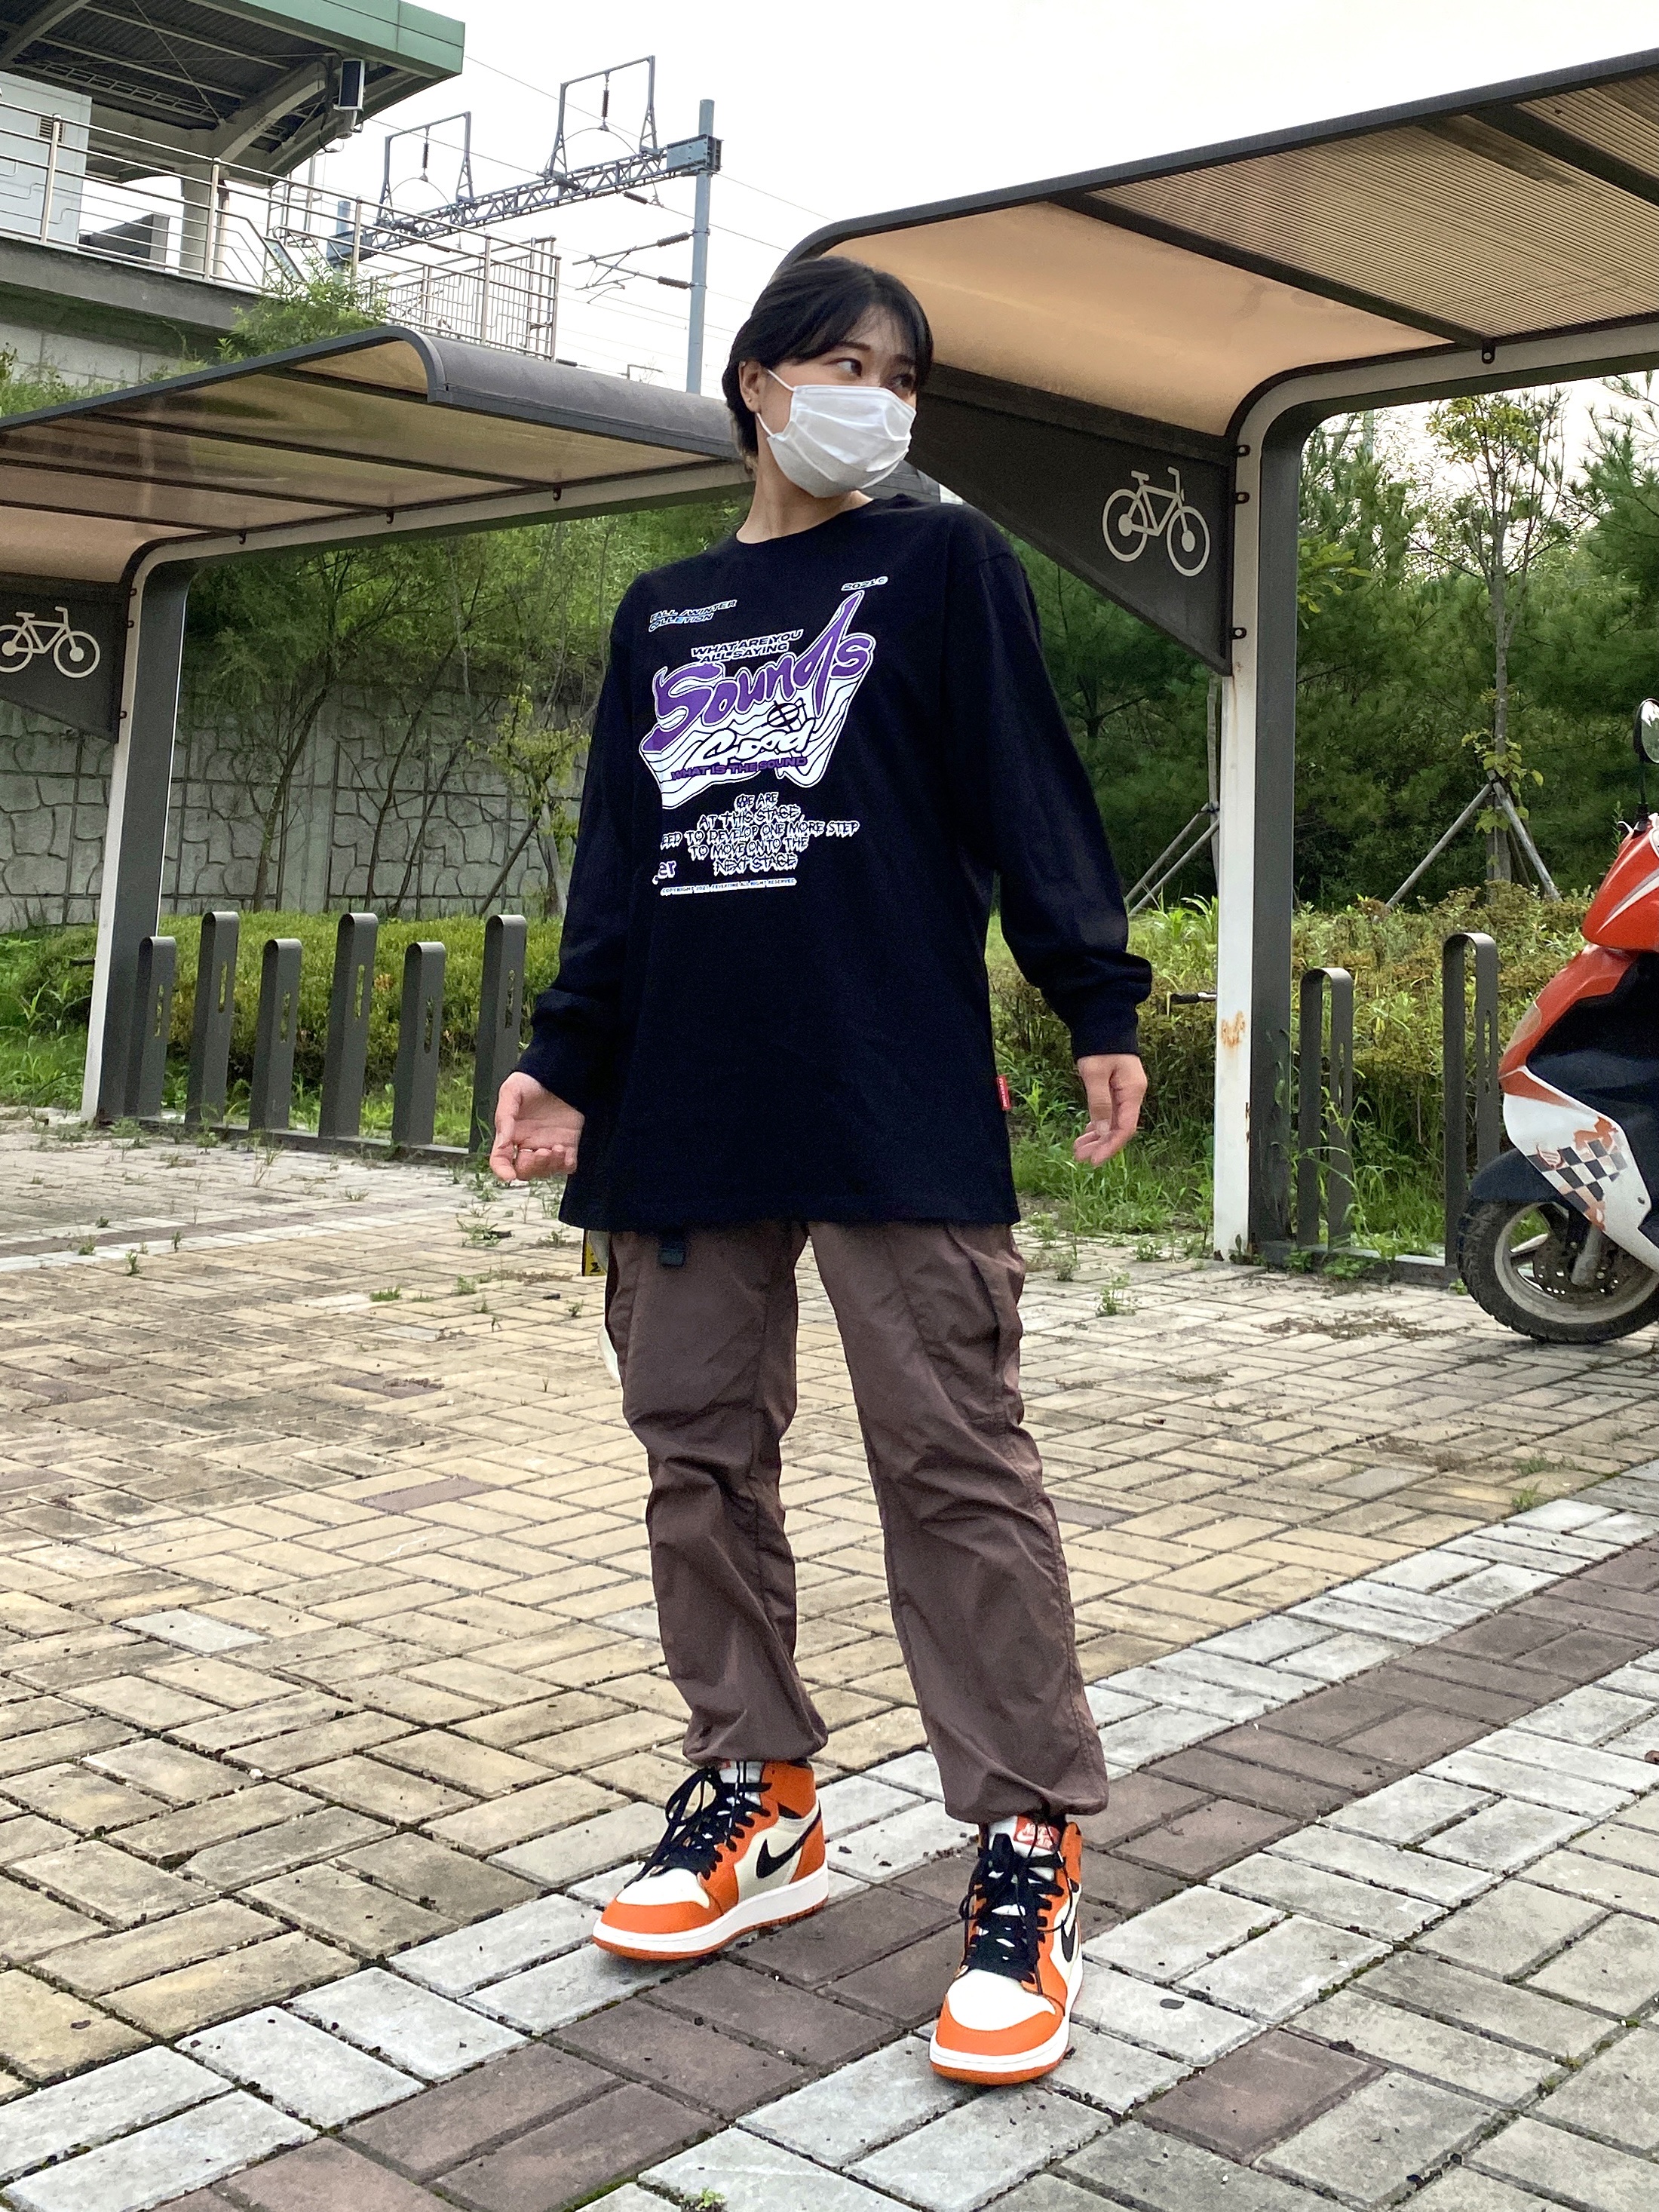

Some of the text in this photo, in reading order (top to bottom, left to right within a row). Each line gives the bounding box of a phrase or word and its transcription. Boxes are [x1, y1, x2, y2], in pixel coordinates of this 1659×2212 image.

[650, 609, 678, 623] FALL
[691, 629, 804, 657] WHAT ARE YOU
[699, 642, 790, 663] ALL SAYING
[670, 756, 808, 780] WHAT IS THE SOUND
[756, 792, 779, 808] ARE
[698, 815, 717, 830] AT
[718, 811, 754, 828] THIS
[684, 830, 705, 845] TO
[707, 825, 759, 844] DEVELOP
[761, 821, 787, 838] ONE
[787, 821, 826, 837] MORE
[826, 821, 860, 838] STEP
[688, 845, 710, 861] TO
[711, 841, 746, 859] MOVE
[784, 836, 809, 852] THE
[714, 853, 798, 876] NEXT STAGE
